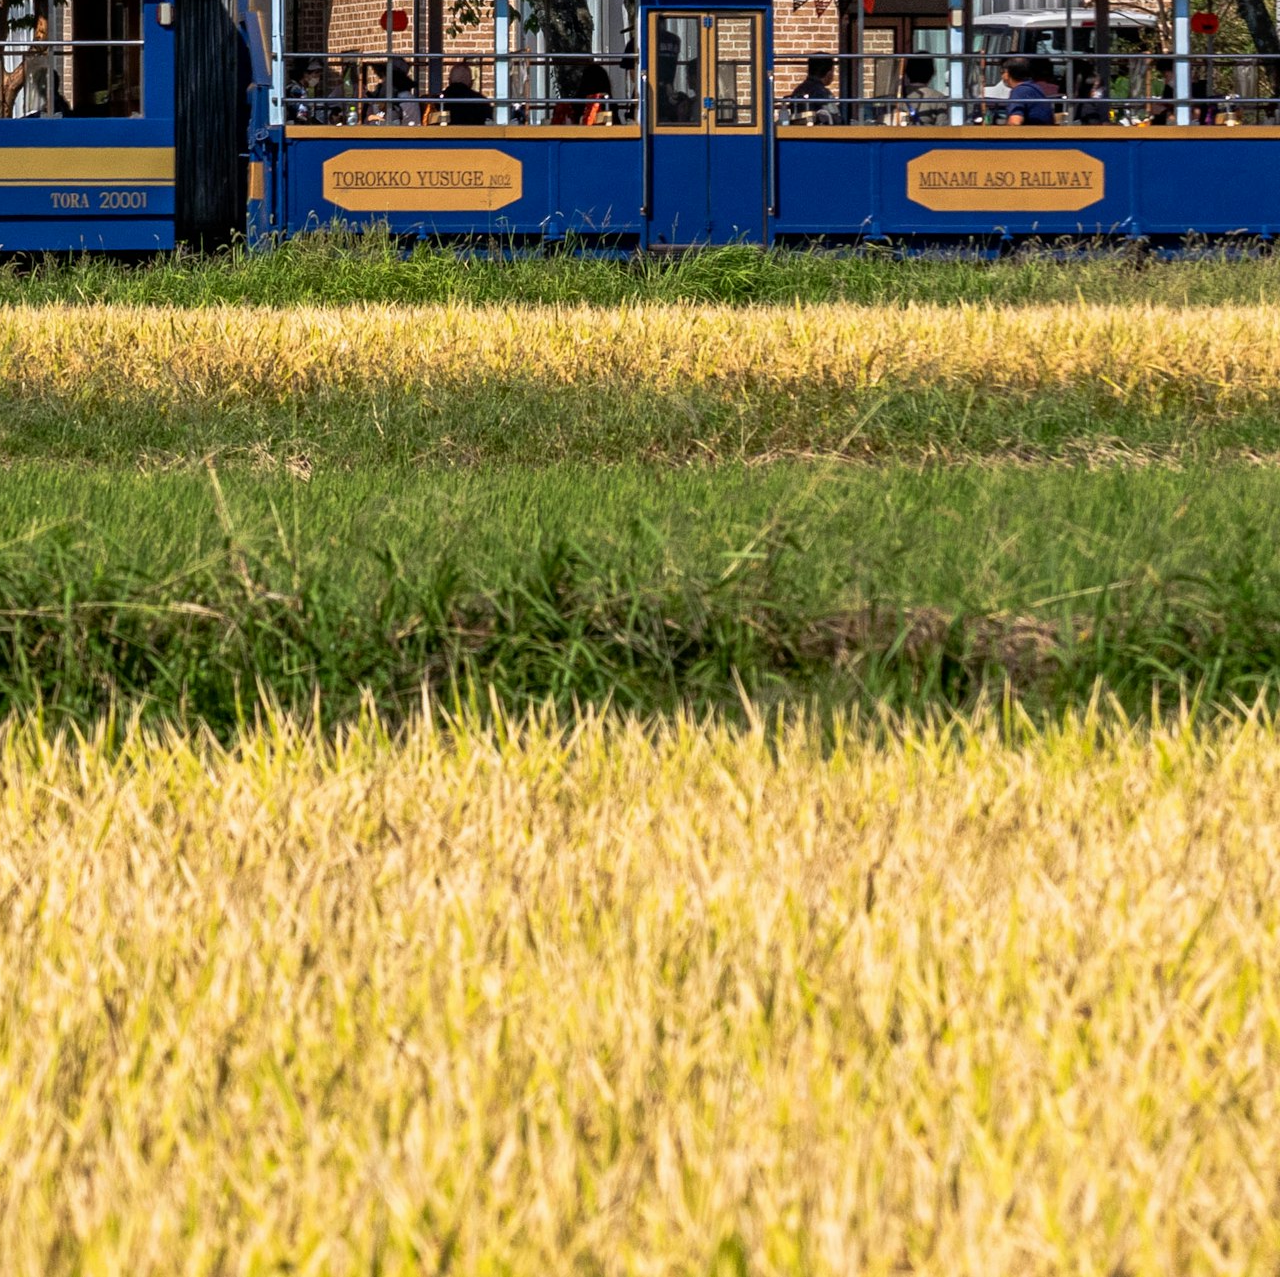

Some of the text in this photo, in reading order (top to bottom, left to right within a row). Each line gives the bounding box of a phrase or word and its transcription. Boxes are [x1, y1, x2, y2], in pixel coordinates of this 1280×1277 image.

[333, 171, 411, 187] TOROKKO
[417, 171, 484, 187] YUSUGE
[919, 171, 1093, 187] MINAMI ASO RAILWAY
[50, 191, 147, 209] TORA 20001
